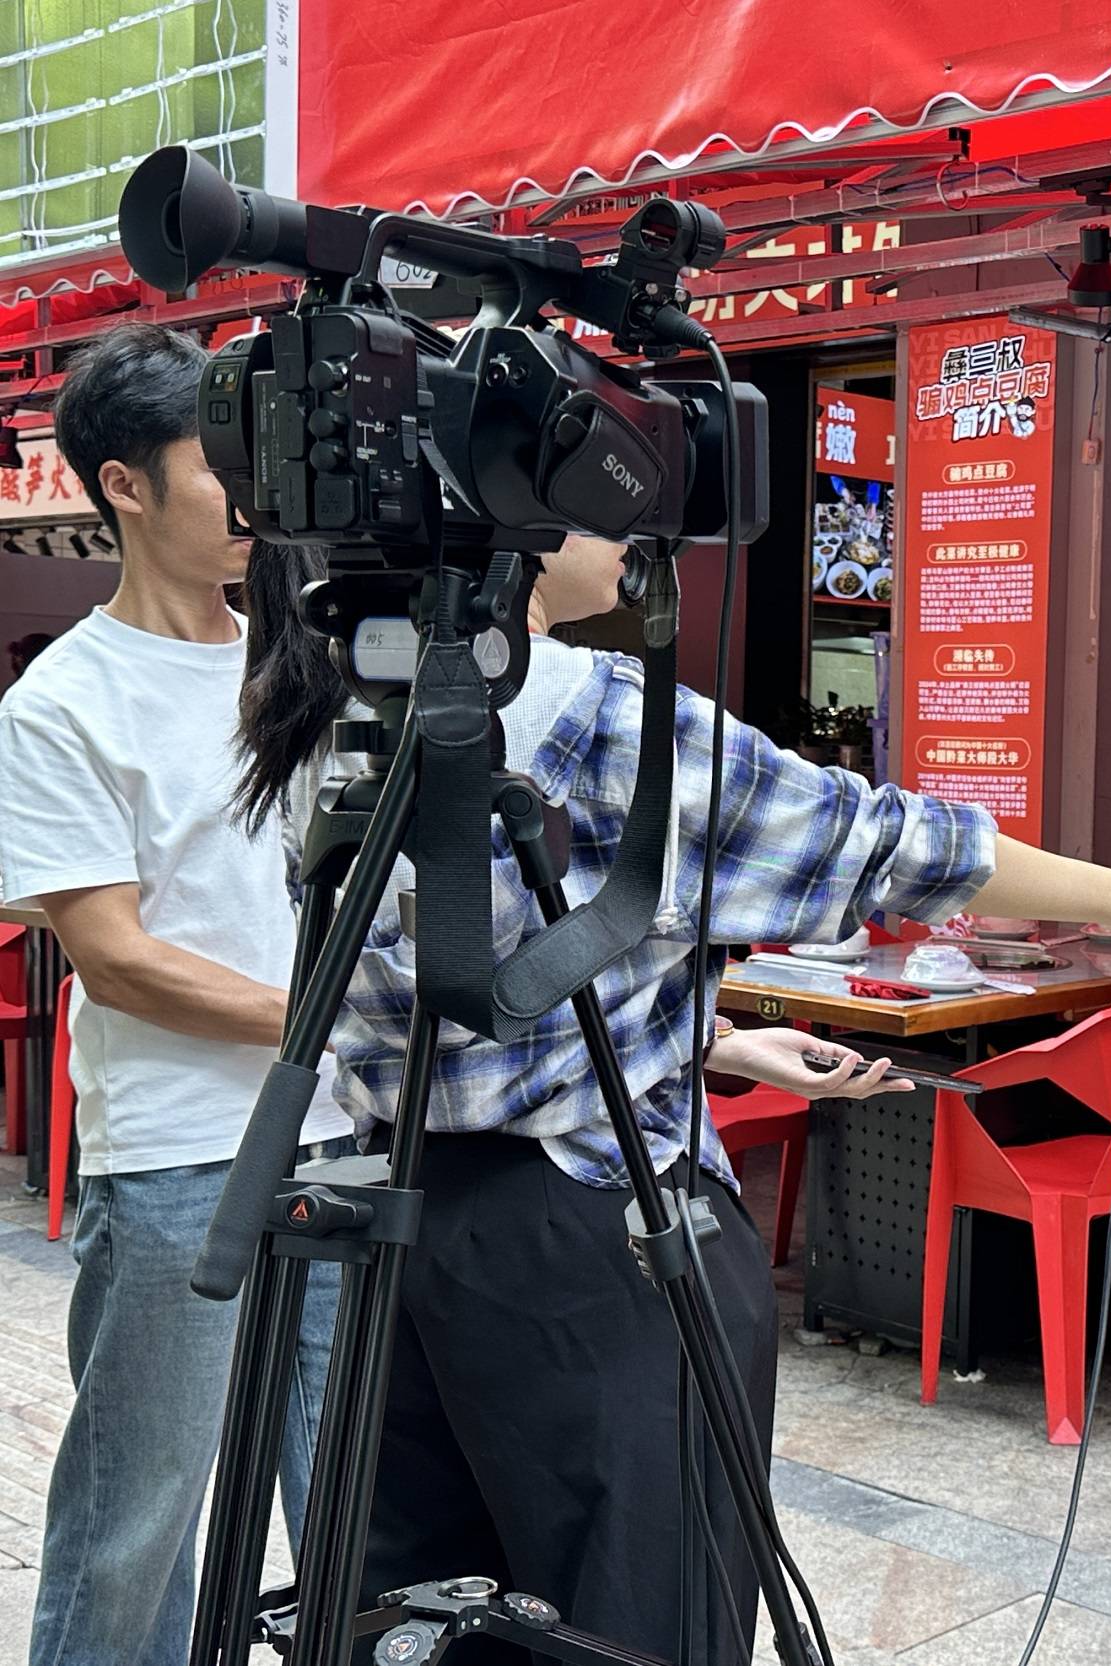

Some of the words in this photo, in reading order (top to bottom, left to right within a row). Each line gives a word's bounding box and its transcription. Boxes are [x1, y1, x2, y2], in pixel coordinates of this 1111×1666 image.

[828, 401, 855, 422] nèn
[953, 402, 1005, 441] 简介
[601, 453, 644, 497] SONY
[763, 1000, 777, 1014] 21
